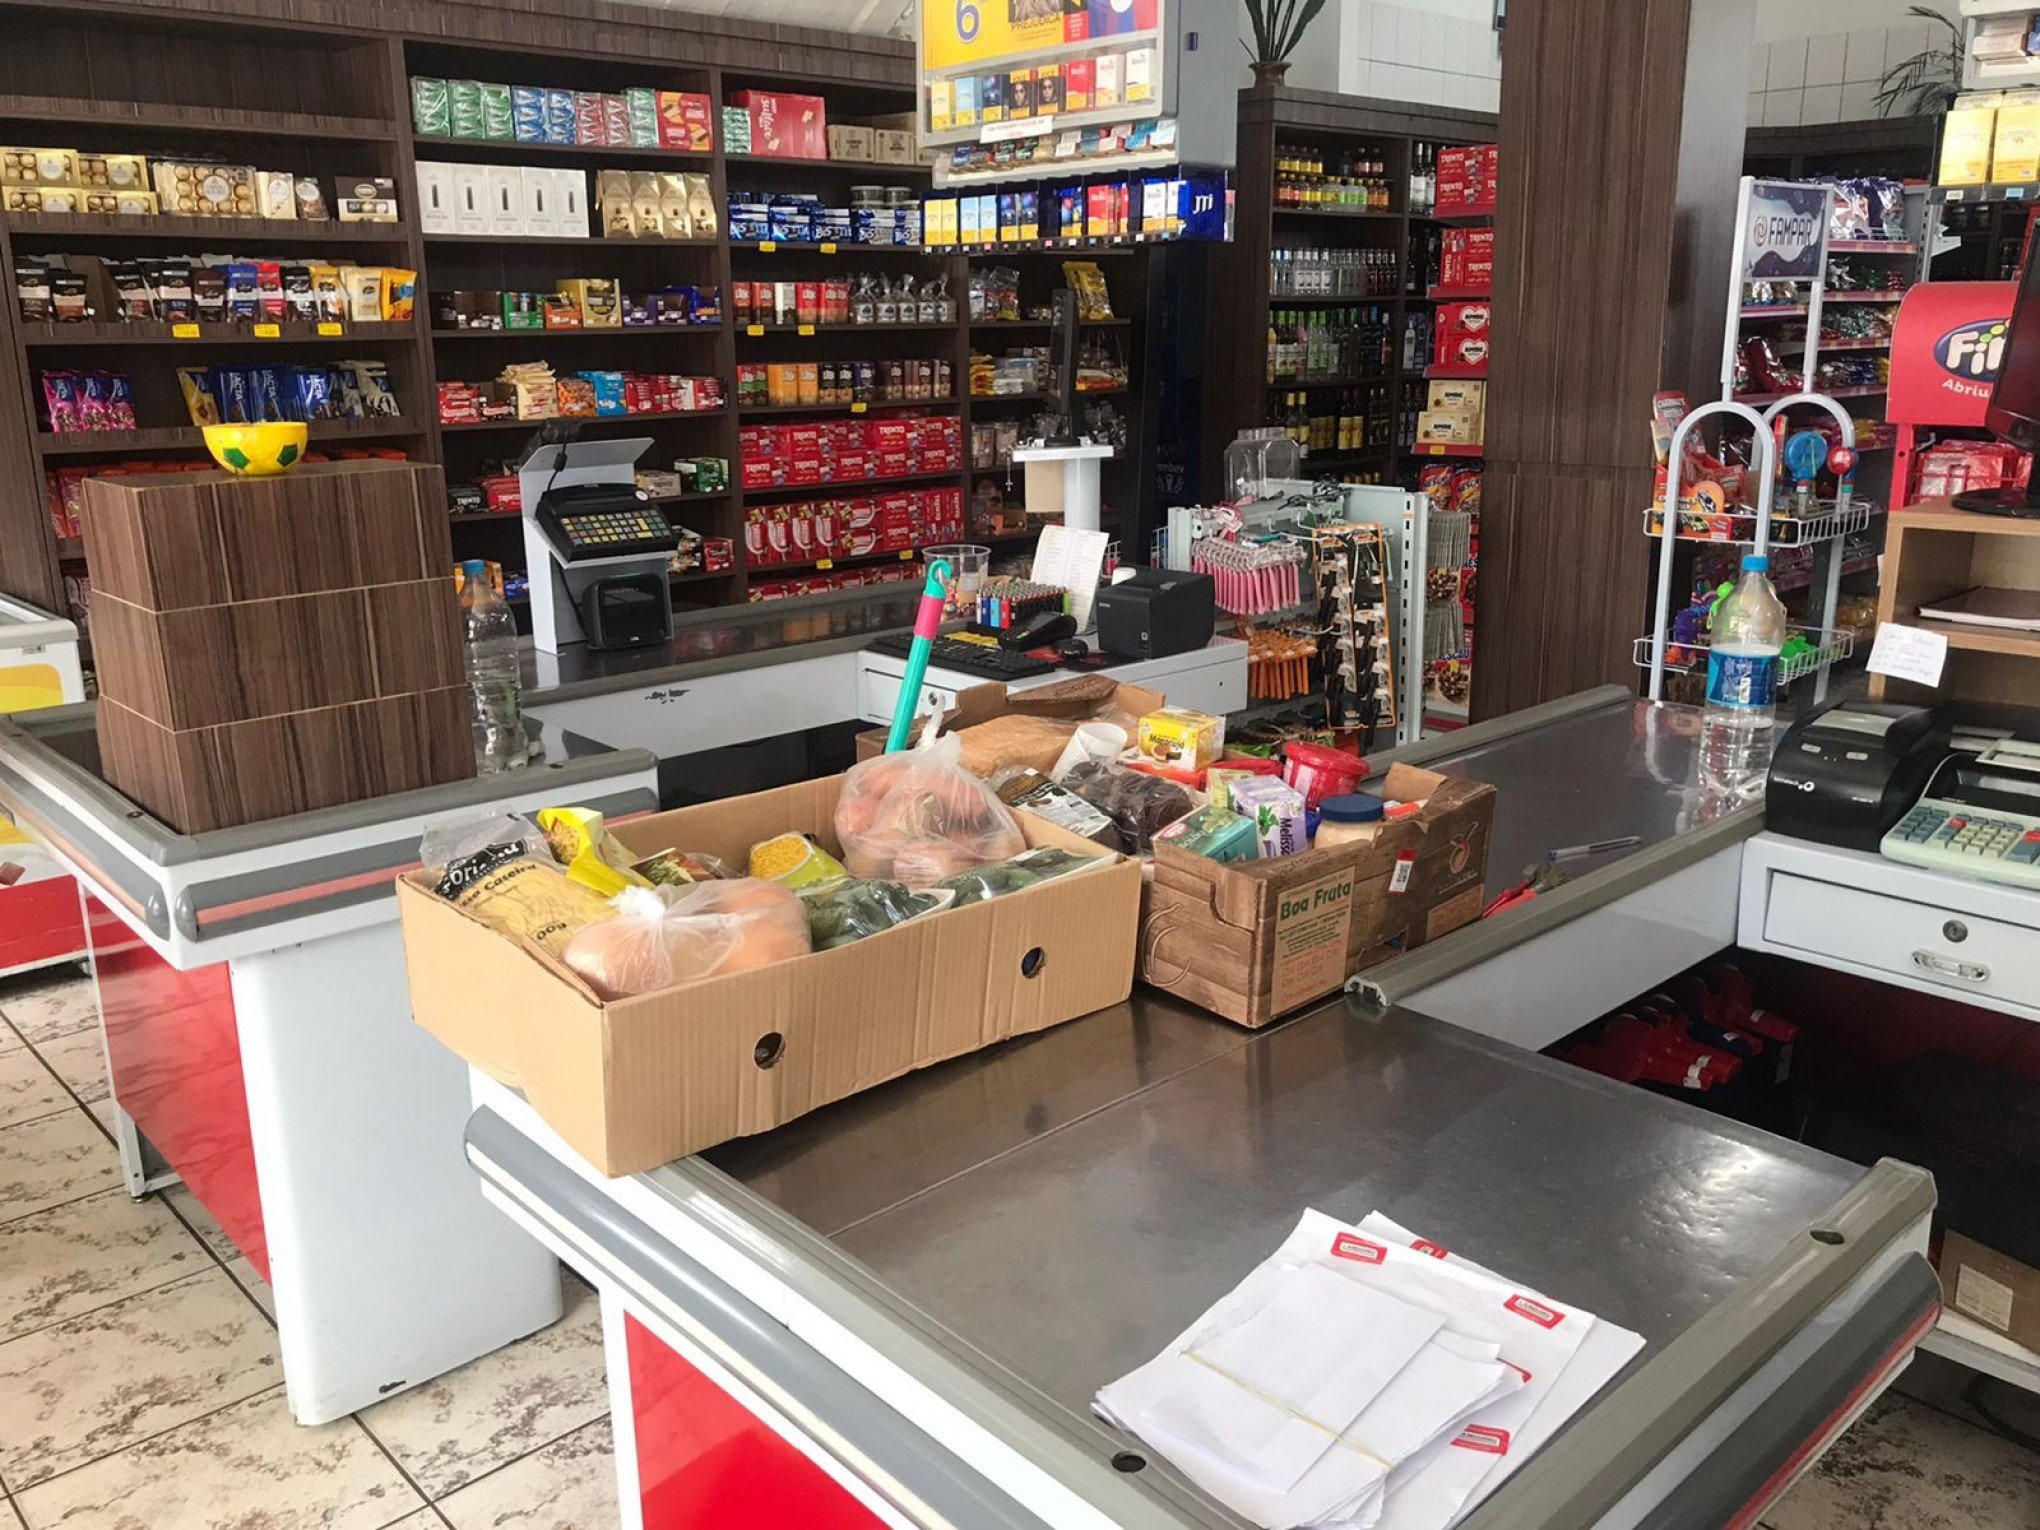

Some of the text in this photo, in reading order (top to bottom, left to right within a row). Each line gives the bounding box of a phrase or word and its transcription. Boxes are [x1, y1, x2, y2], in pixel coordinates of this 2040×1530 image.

[1768, 216, 1814, 247] FAMPAR
[1941, 379, 1990, 399] Abriu
[1280, 881, 1352, 920] Boa Fruta
